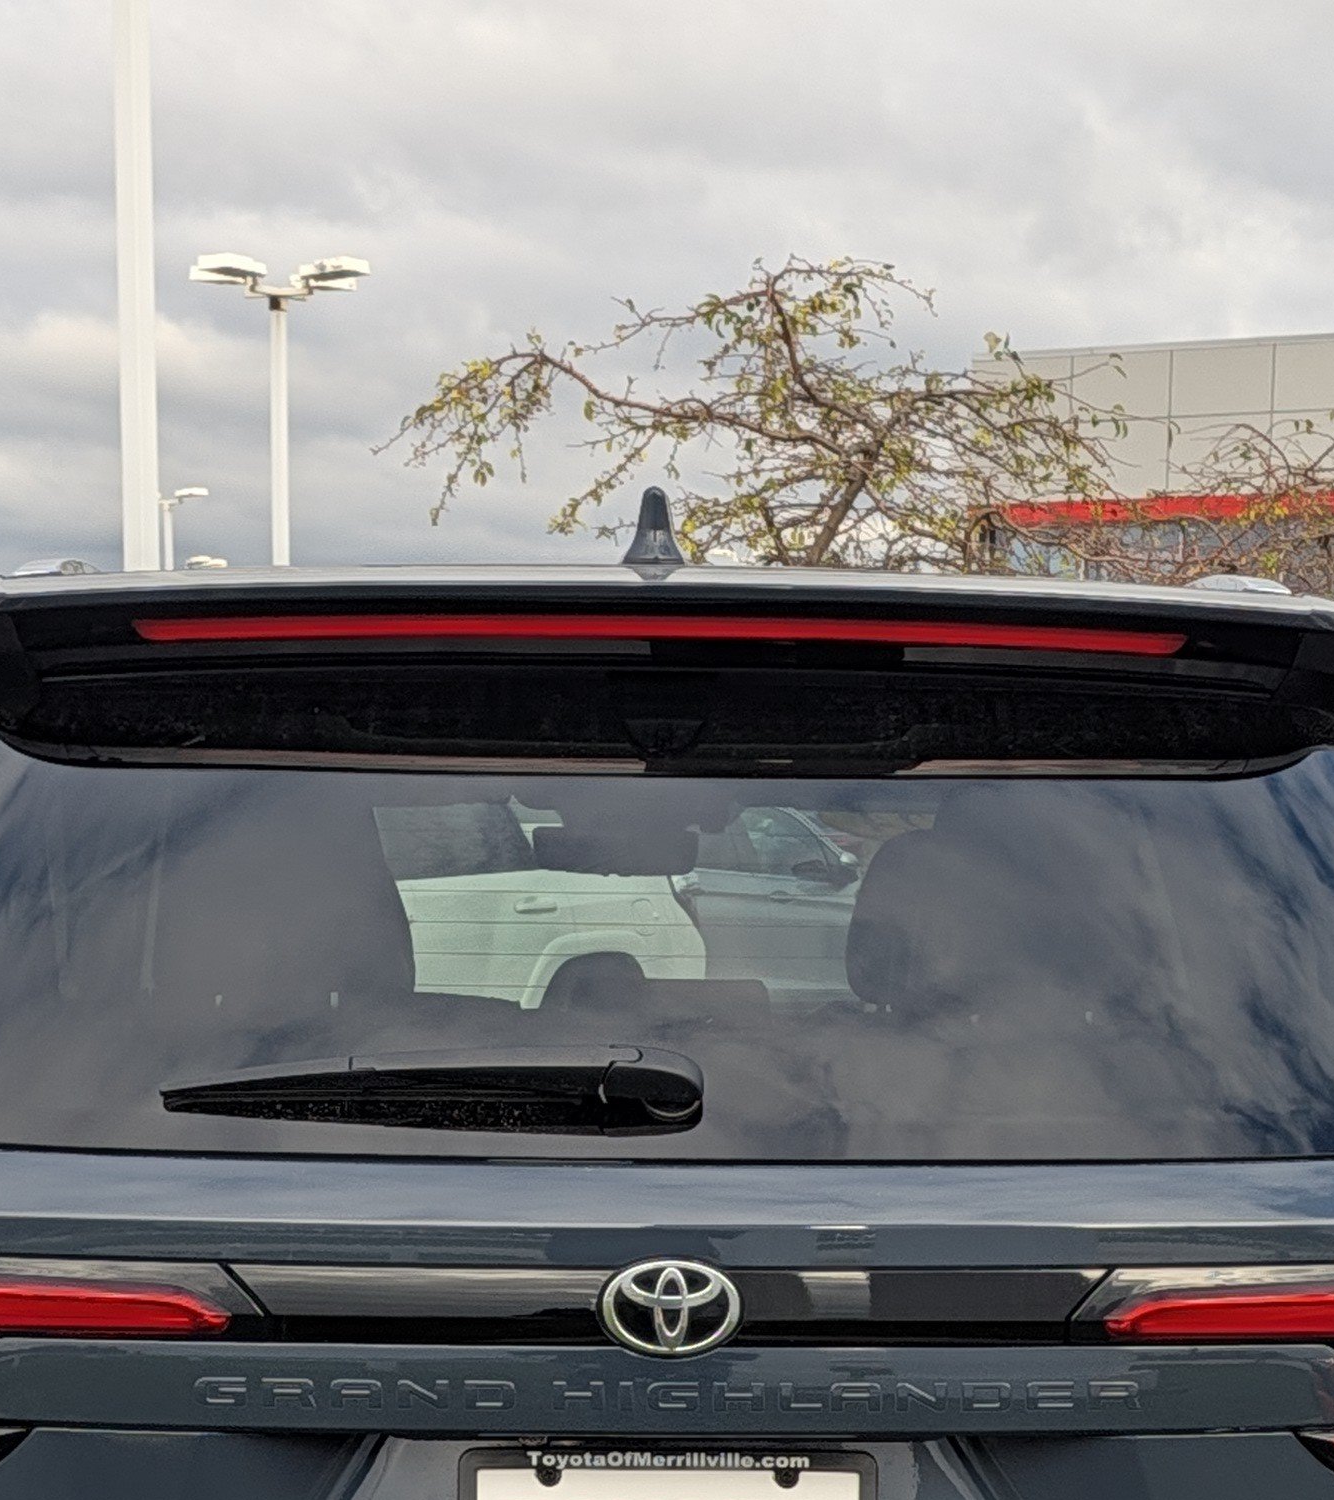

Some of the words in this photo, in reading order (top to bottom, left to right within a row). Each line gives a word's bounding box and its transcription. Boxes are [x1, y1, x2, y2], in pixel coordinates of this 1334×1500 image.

[193, 1376, 515, 1411] GRAND
[552, 1381, 1141, 1411] HIGHLANDER
[527, 1450, 810, 1471] ToyotaOfMerrillville.com
